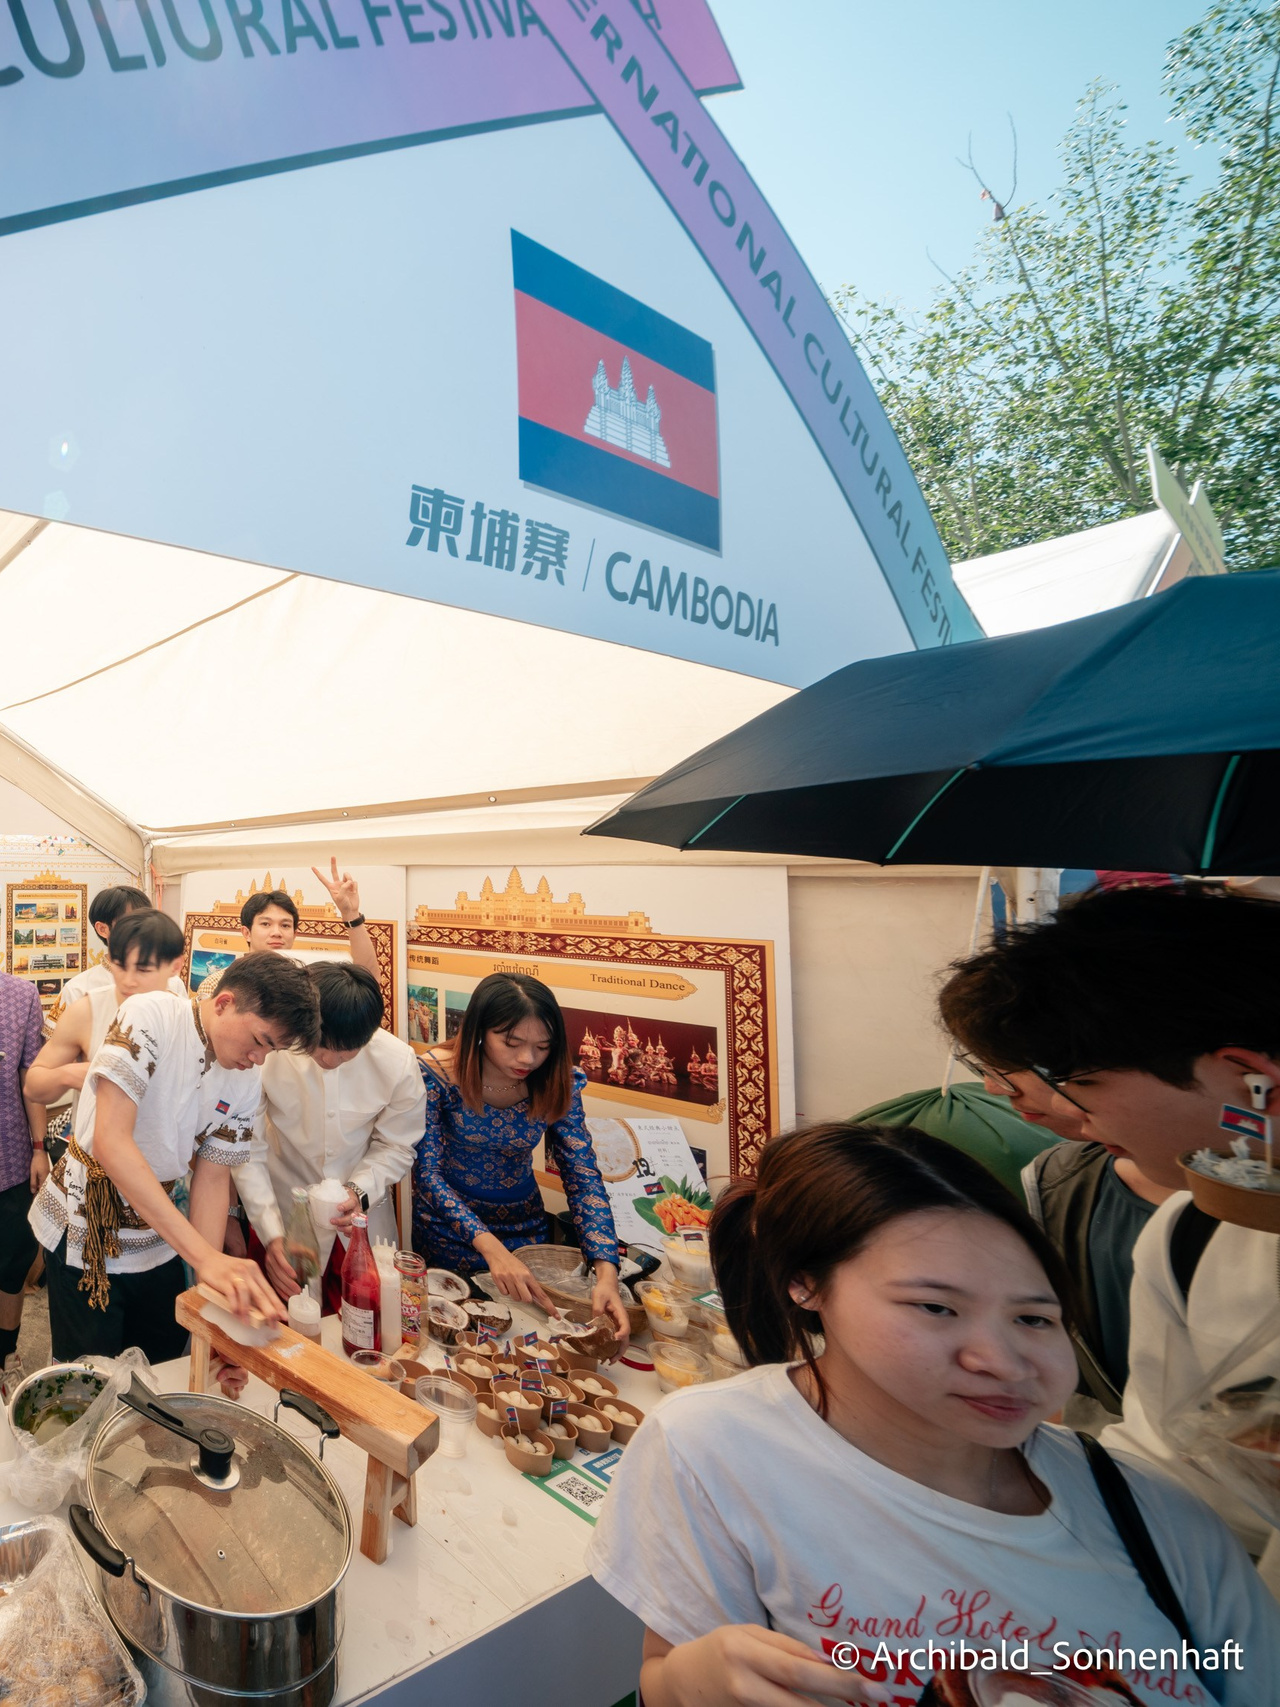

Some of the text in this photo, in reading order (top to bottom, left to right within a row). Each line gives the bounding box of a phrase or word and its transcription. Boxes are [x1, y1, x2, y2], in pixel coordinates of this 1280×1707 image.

[803, 331, 910, 559] CULTURAL
[911, 545, 952, 647] FESTI
[405, 483, 571, 587] 柬埔寨
[605, 550, 780, 647] CAMBODIA
[409, 954, 440, 966] 传统舞蹈
[589, 973, 686, 992] Traditional Dance
[632, 1157, 656, 1179] 12
[806, 1582, 927, 1640] Grand
[935, 1588, 1058, 1651] Hotel
